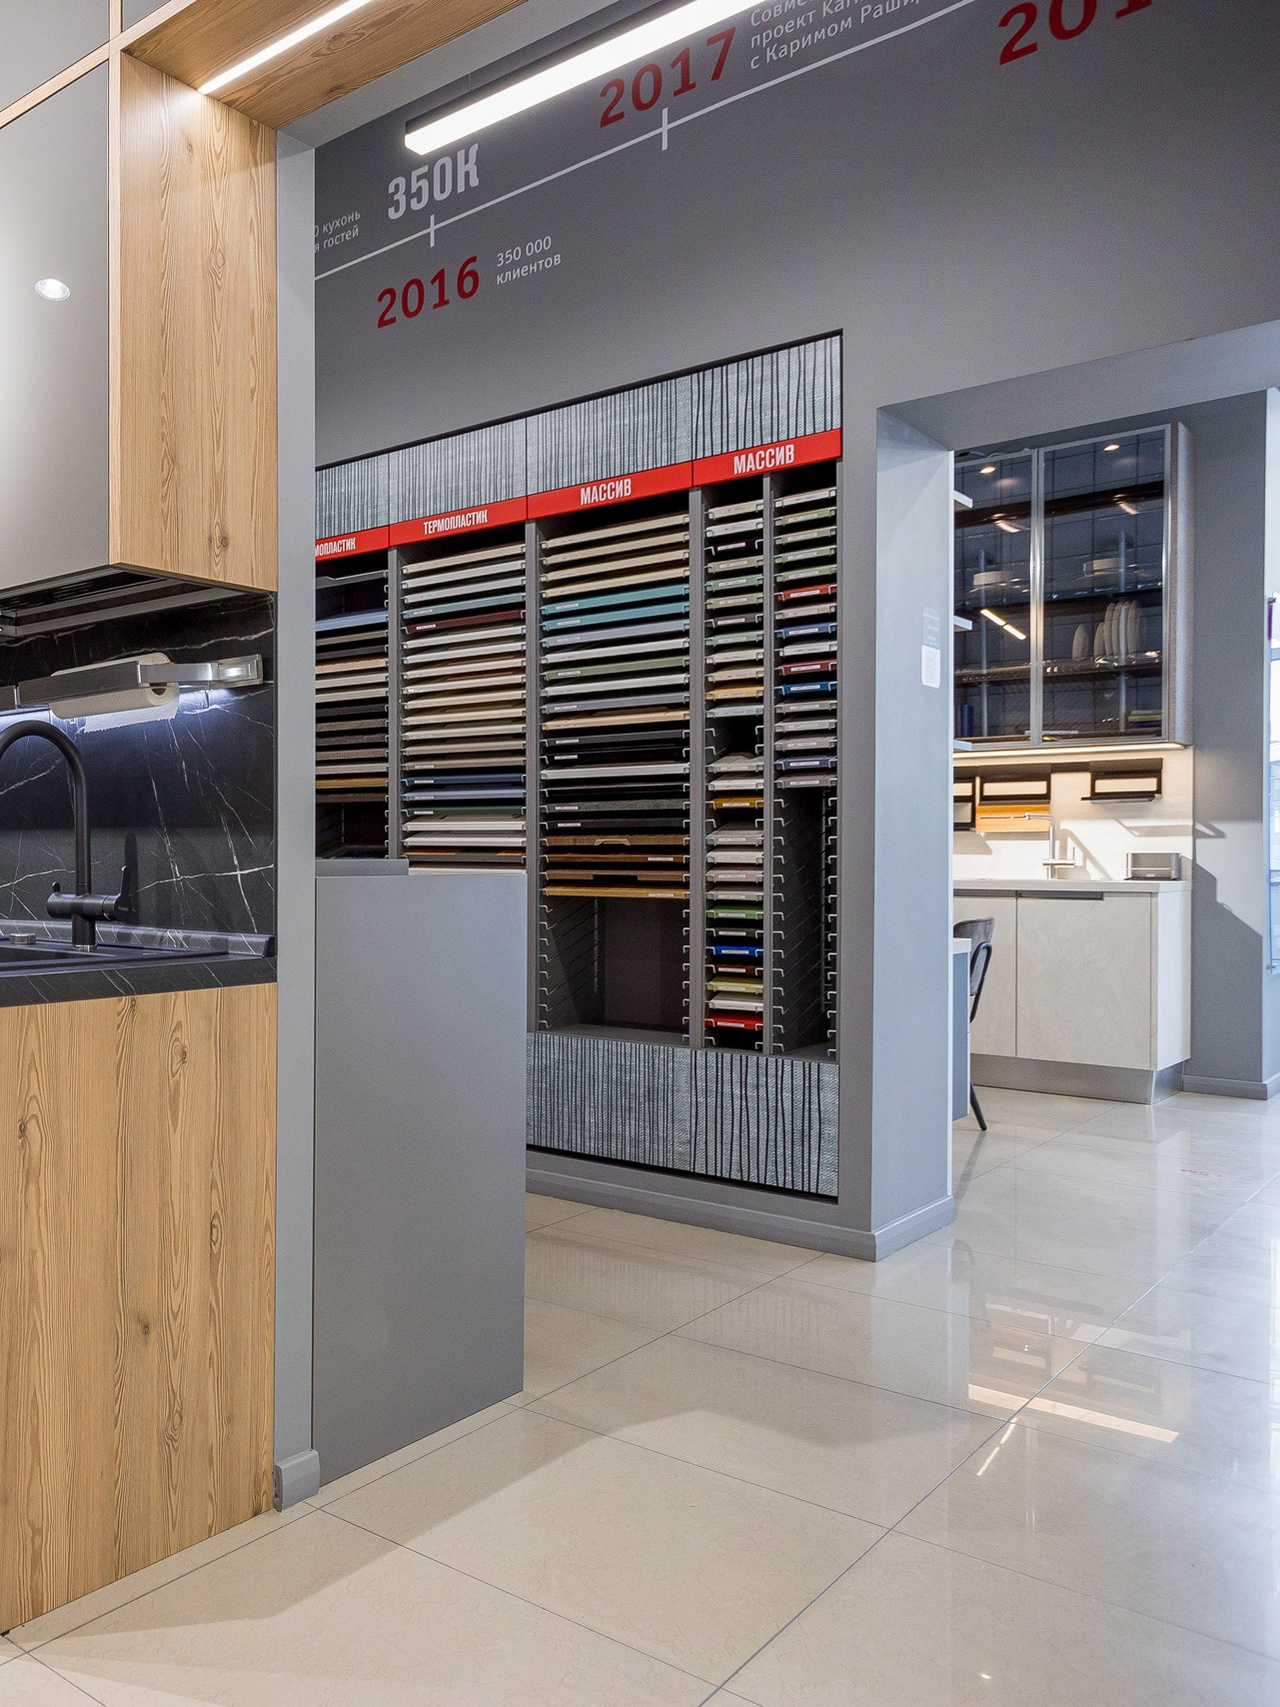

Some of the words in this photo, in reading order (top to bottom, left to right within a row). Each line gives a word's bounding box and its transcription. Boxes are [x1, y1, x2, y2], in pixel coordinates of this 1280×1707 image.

[750, 0, 811, 27] Совме
[751, 10, 816, 49] проект
[750, 56, 760, 69] с
[766, 16, 852, 64] Каримом
[860, 0, 920, 24] Раш
[998, 0, 1153, 65] 20
[599, 26, 737, 128] 2017
[388, 143, 479, 220] 350К
[322, 211, 361, 235] кухонь
[323, 224, 360, 250] гостей
[496, 246, 522, 268] 350
[525, 235, 552, 257] 000
[496, 253, 562, 286] клиентов
[377, 256, 480, 329] 2016
[733, 444, 795, 475] МАССИВ
[580, 478, 632, 505] МАССИВ
[423, 509, 488, 535] ТЕРМОПЛАСТИК
